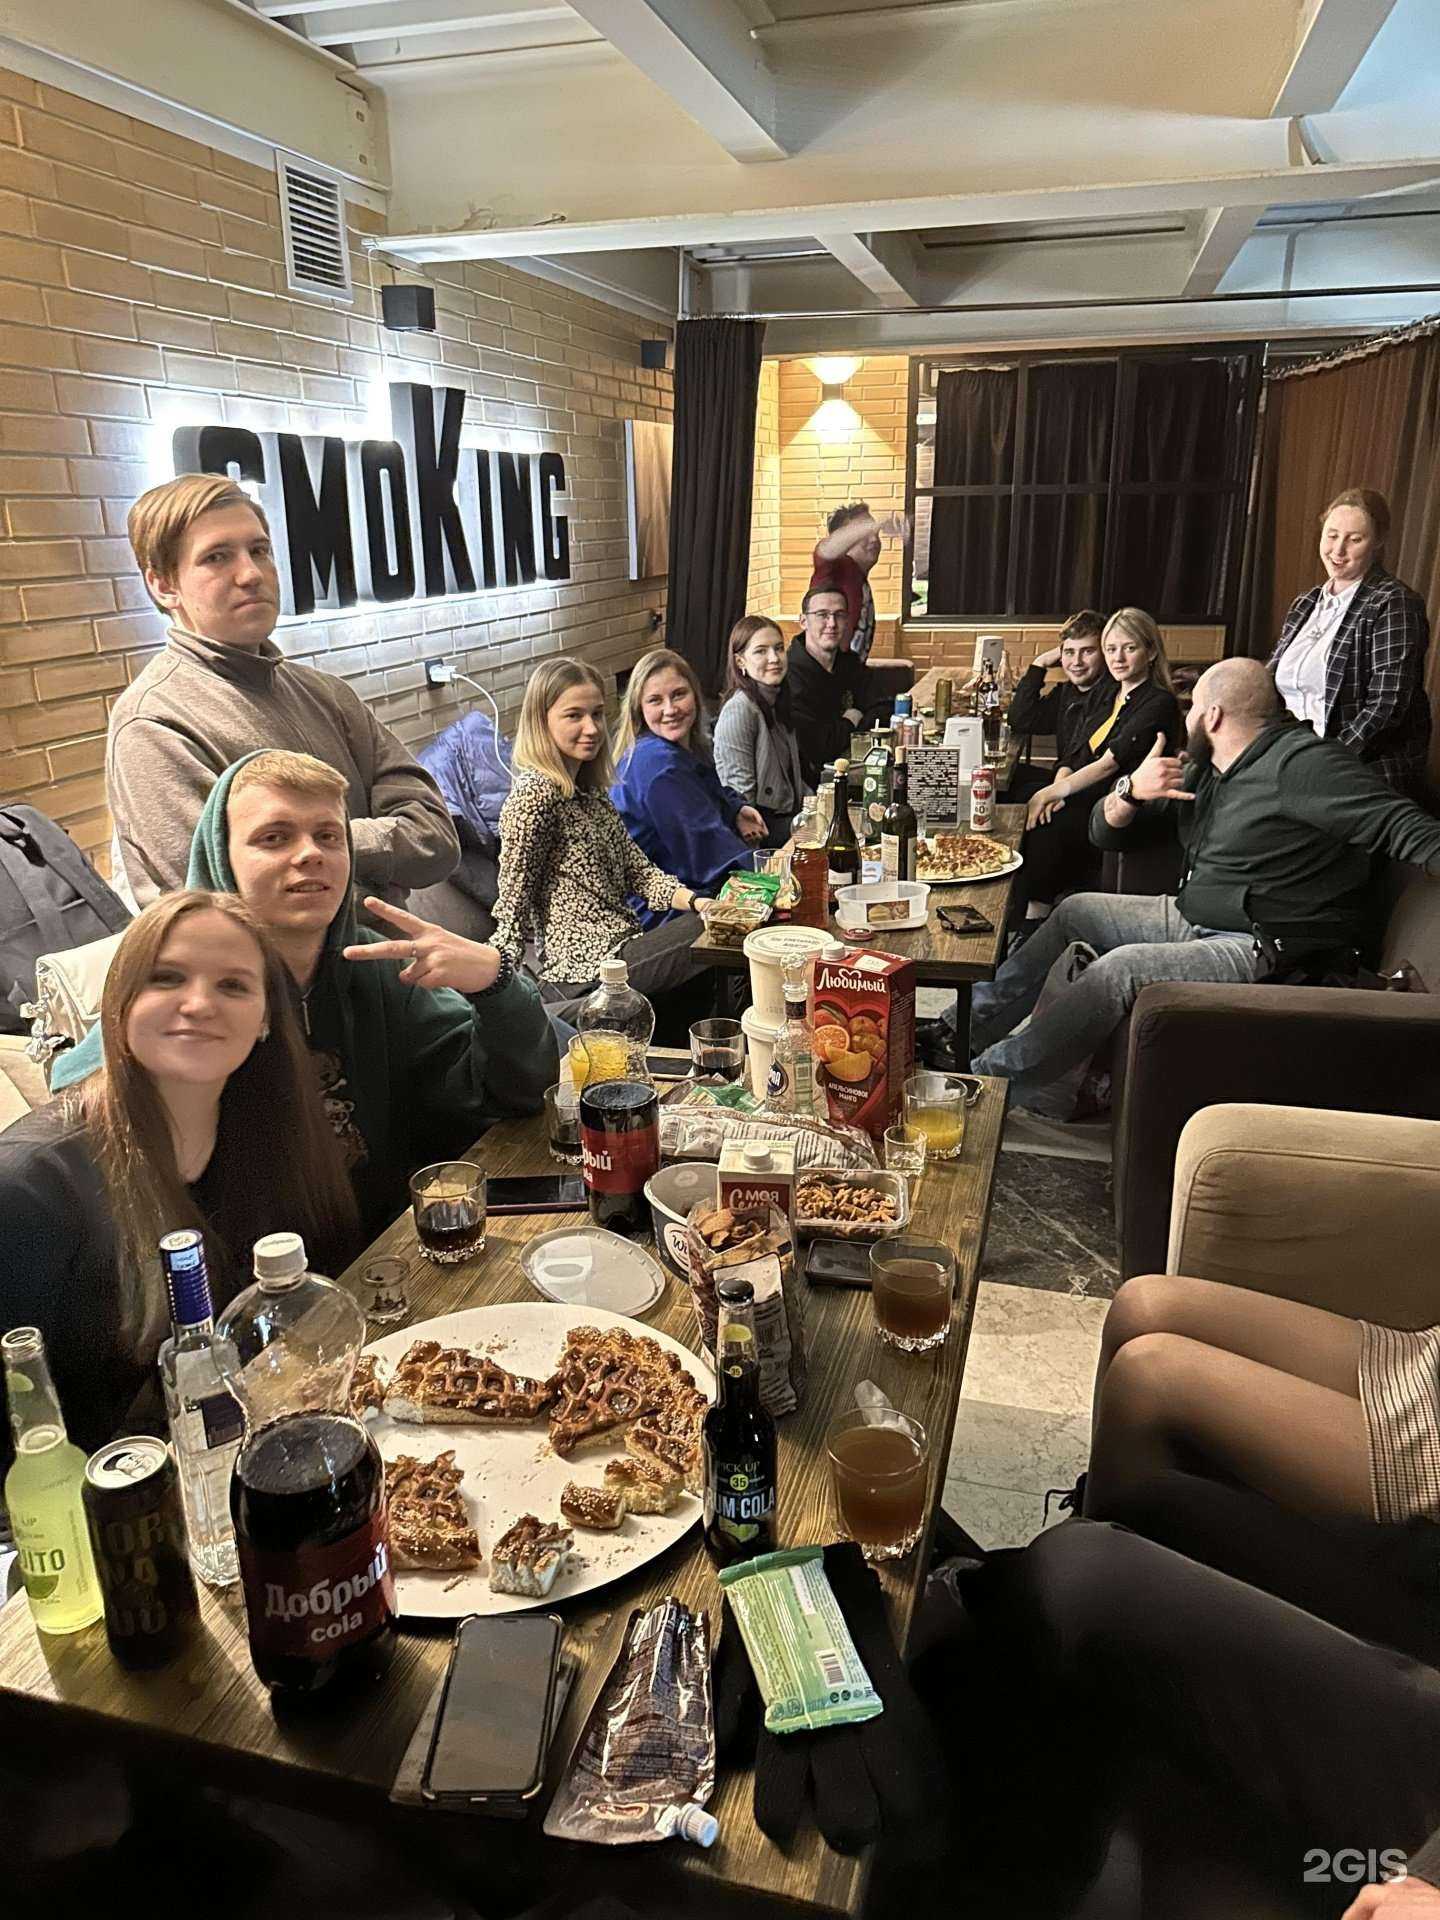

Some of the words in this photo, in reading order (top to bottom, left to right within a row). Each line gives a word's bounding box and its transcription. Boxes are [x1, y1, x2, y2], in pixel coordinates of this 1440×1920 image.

[816, 967, 887, 993] Любимый
[581, 1140, 612, 1171] рый
[732, 1477, 746, 1488] 35
[744, 1461, 761, 1473] UP
[740, 1485, 776, 1519] COLA
[264, 1541, 388, 1622] Добрый
[310, 1611, 363, 1643] cola
